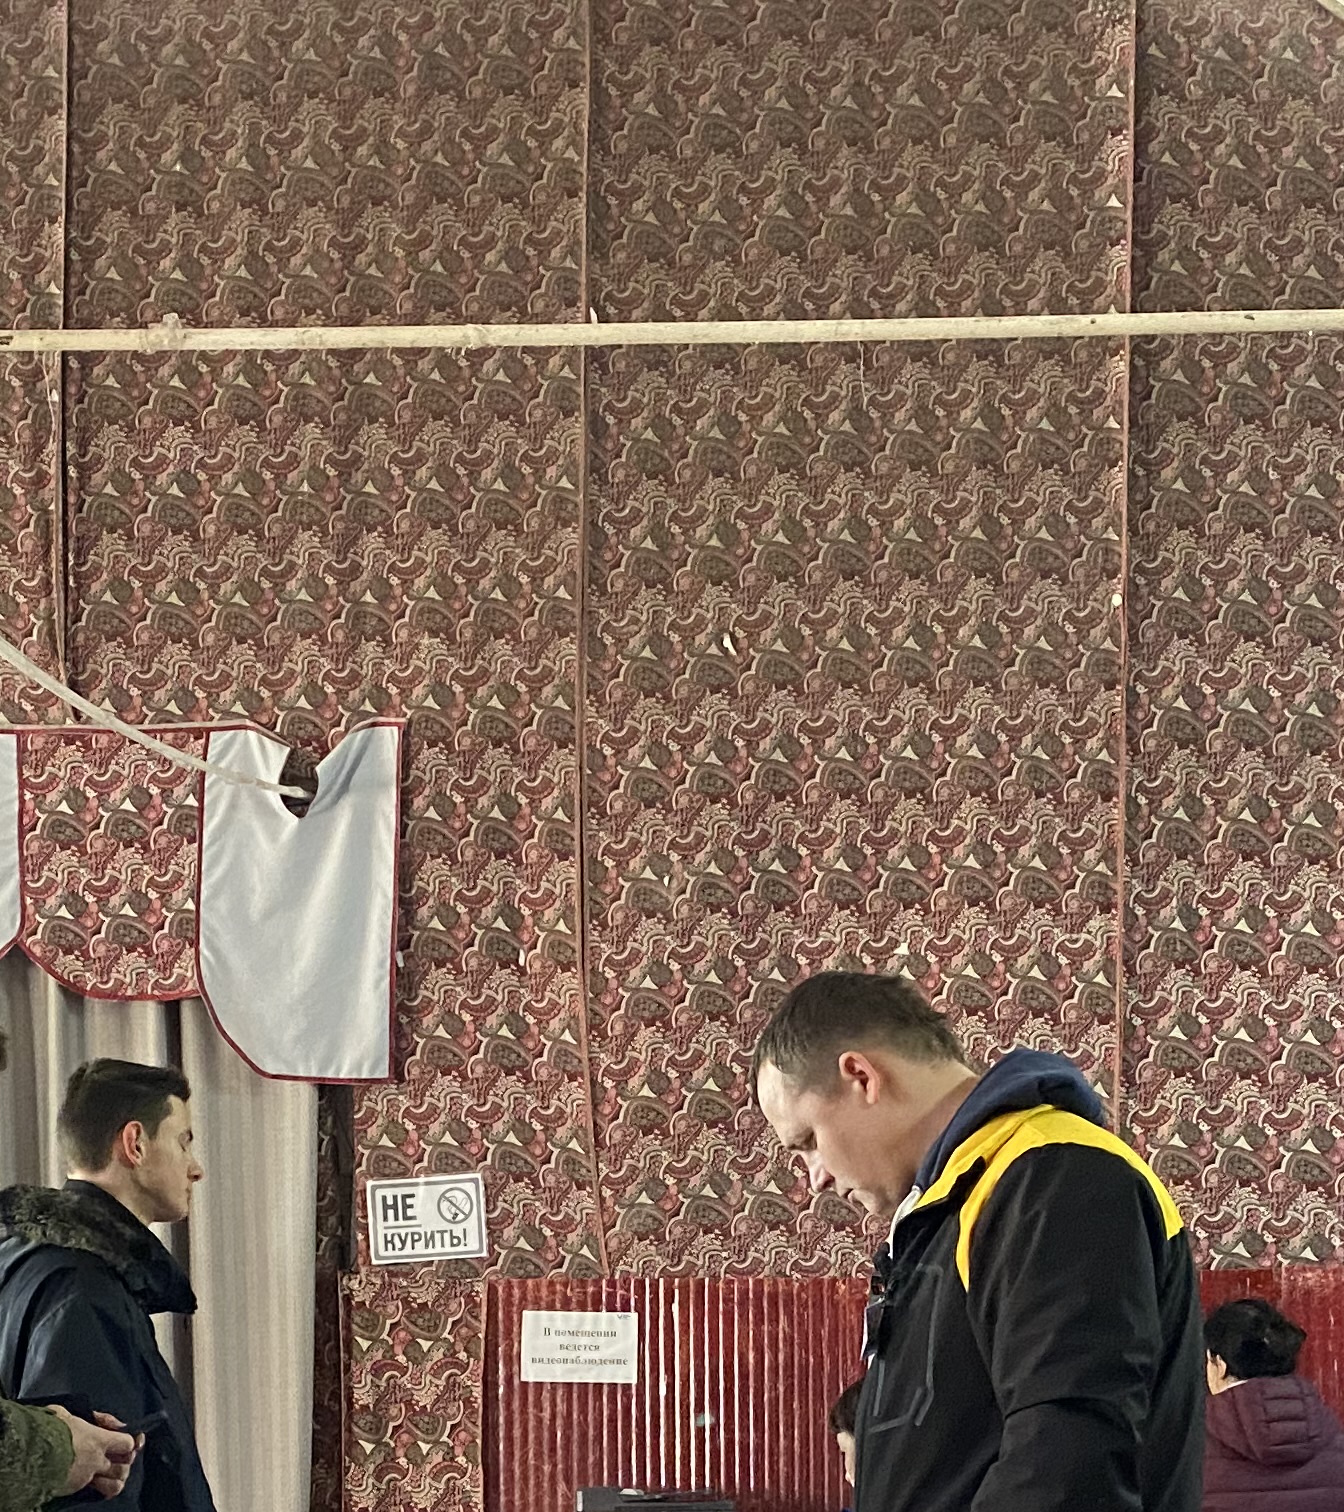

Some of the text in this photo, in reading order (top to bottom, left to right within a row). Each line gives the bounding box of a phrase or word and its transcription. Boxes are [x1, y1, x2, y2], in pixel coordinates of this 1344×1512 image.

[381, 1193, 417, 1222] НЕ
[383, 1228, 468, 1252] КУРИТЬ!
[543, 1327, 551, 1337] В
